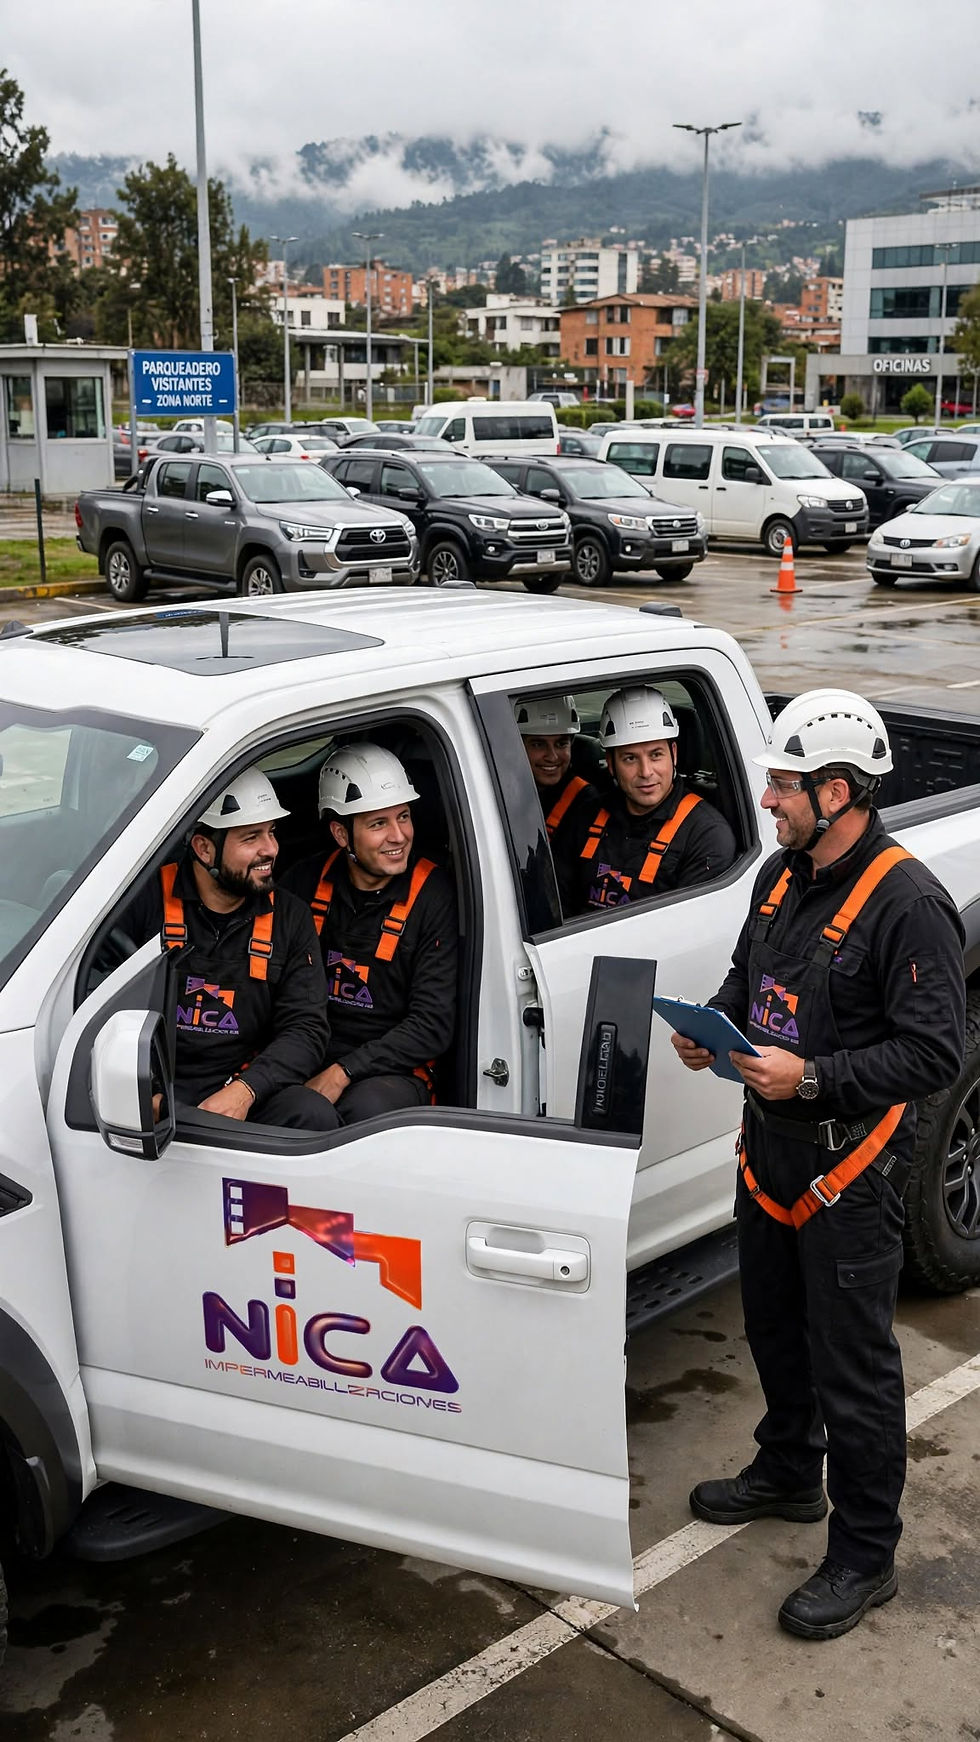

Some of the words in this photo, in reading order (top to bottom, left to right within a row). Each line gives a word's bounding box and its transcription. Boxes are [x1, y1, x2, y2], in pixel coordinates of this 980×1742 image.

[142, 361, 221, 376] PARQUEADERO
[873, 359, 931, 373] OFICINAS
[151, 377, 212, 392] VISITANTES
[156, 394, 181, 407] ZONA
[183, 394, 213, 407] NORTE
